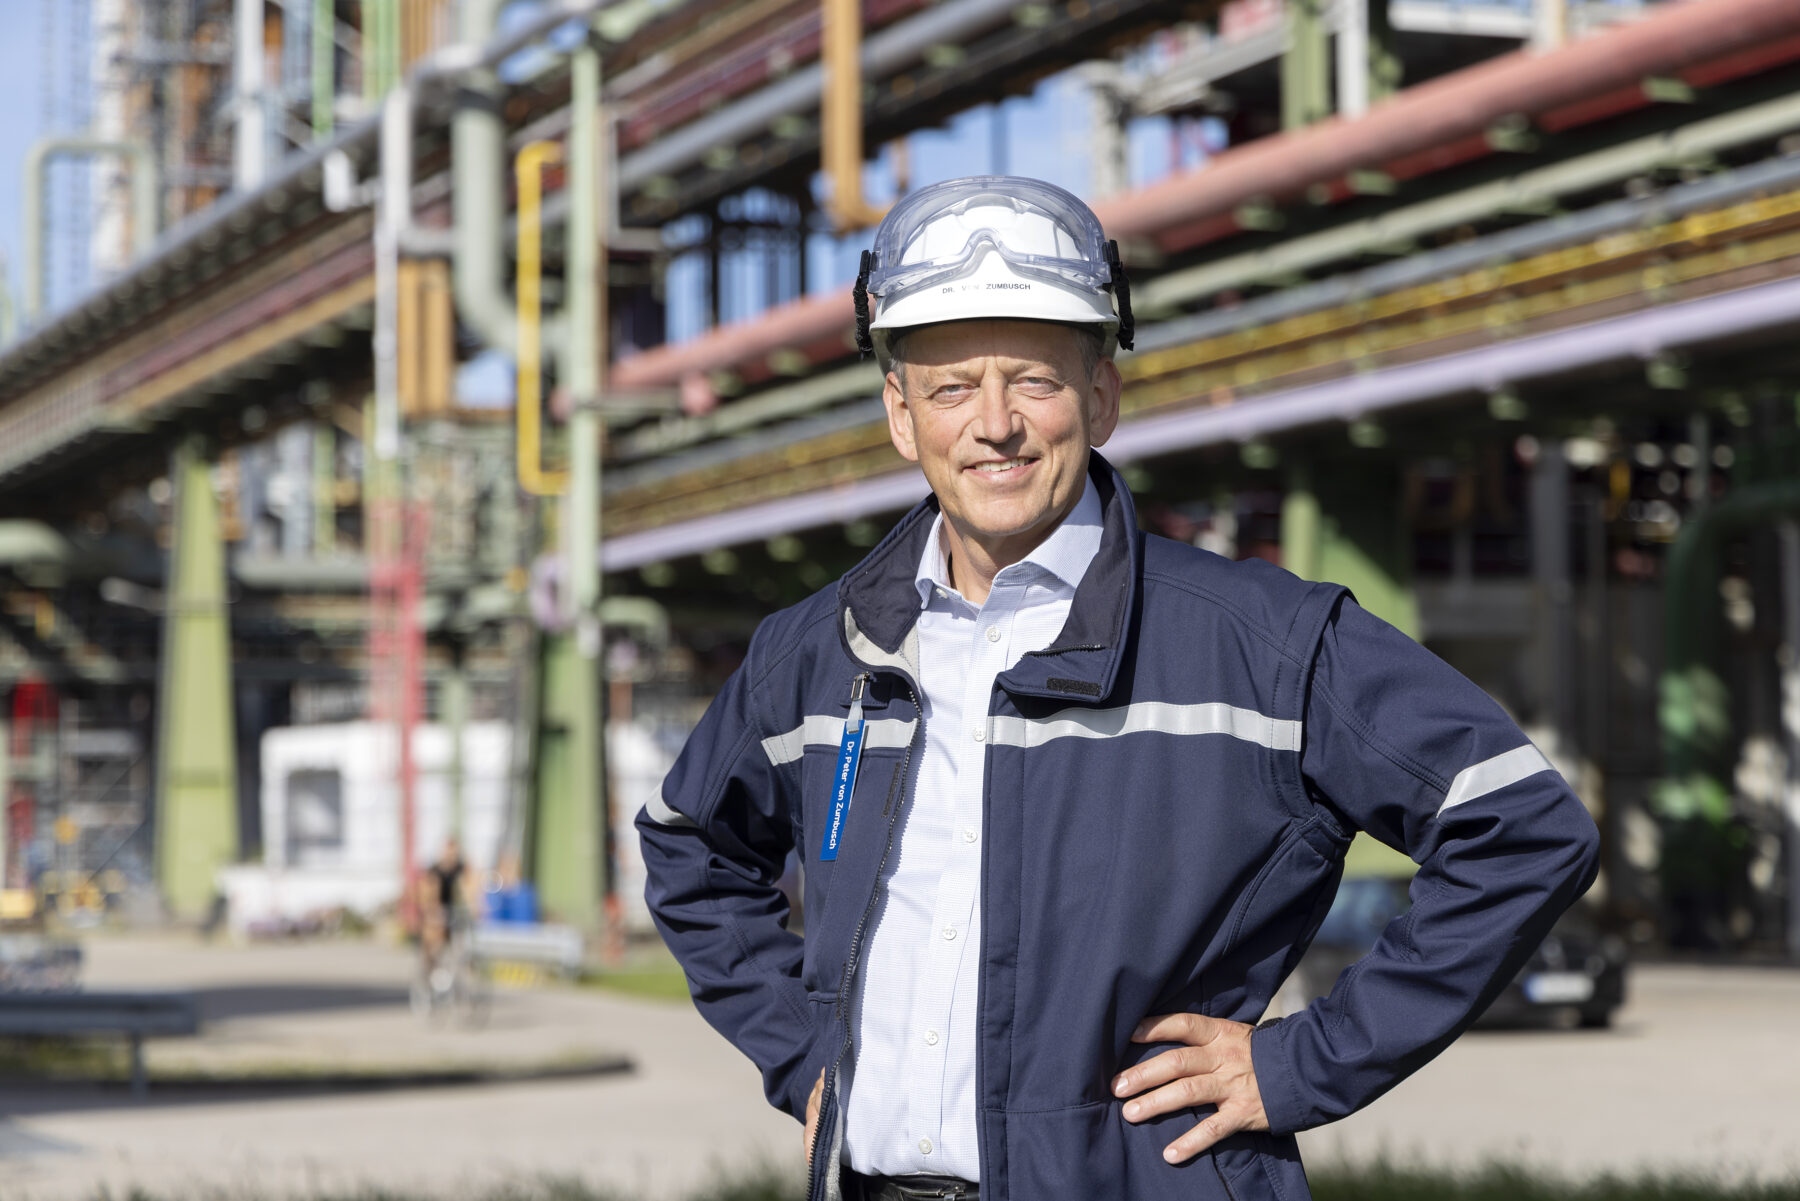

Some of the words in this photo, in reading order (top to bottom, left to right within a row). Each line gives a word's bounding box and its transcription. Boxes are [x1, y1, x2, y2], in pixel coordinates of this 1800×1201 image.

[845, 741, 855, 756] Dr.
[841, 756, 852, 783] Peter
[837, 783, 846, 801] von
[829, 802, 844, 850] Zumbusch
